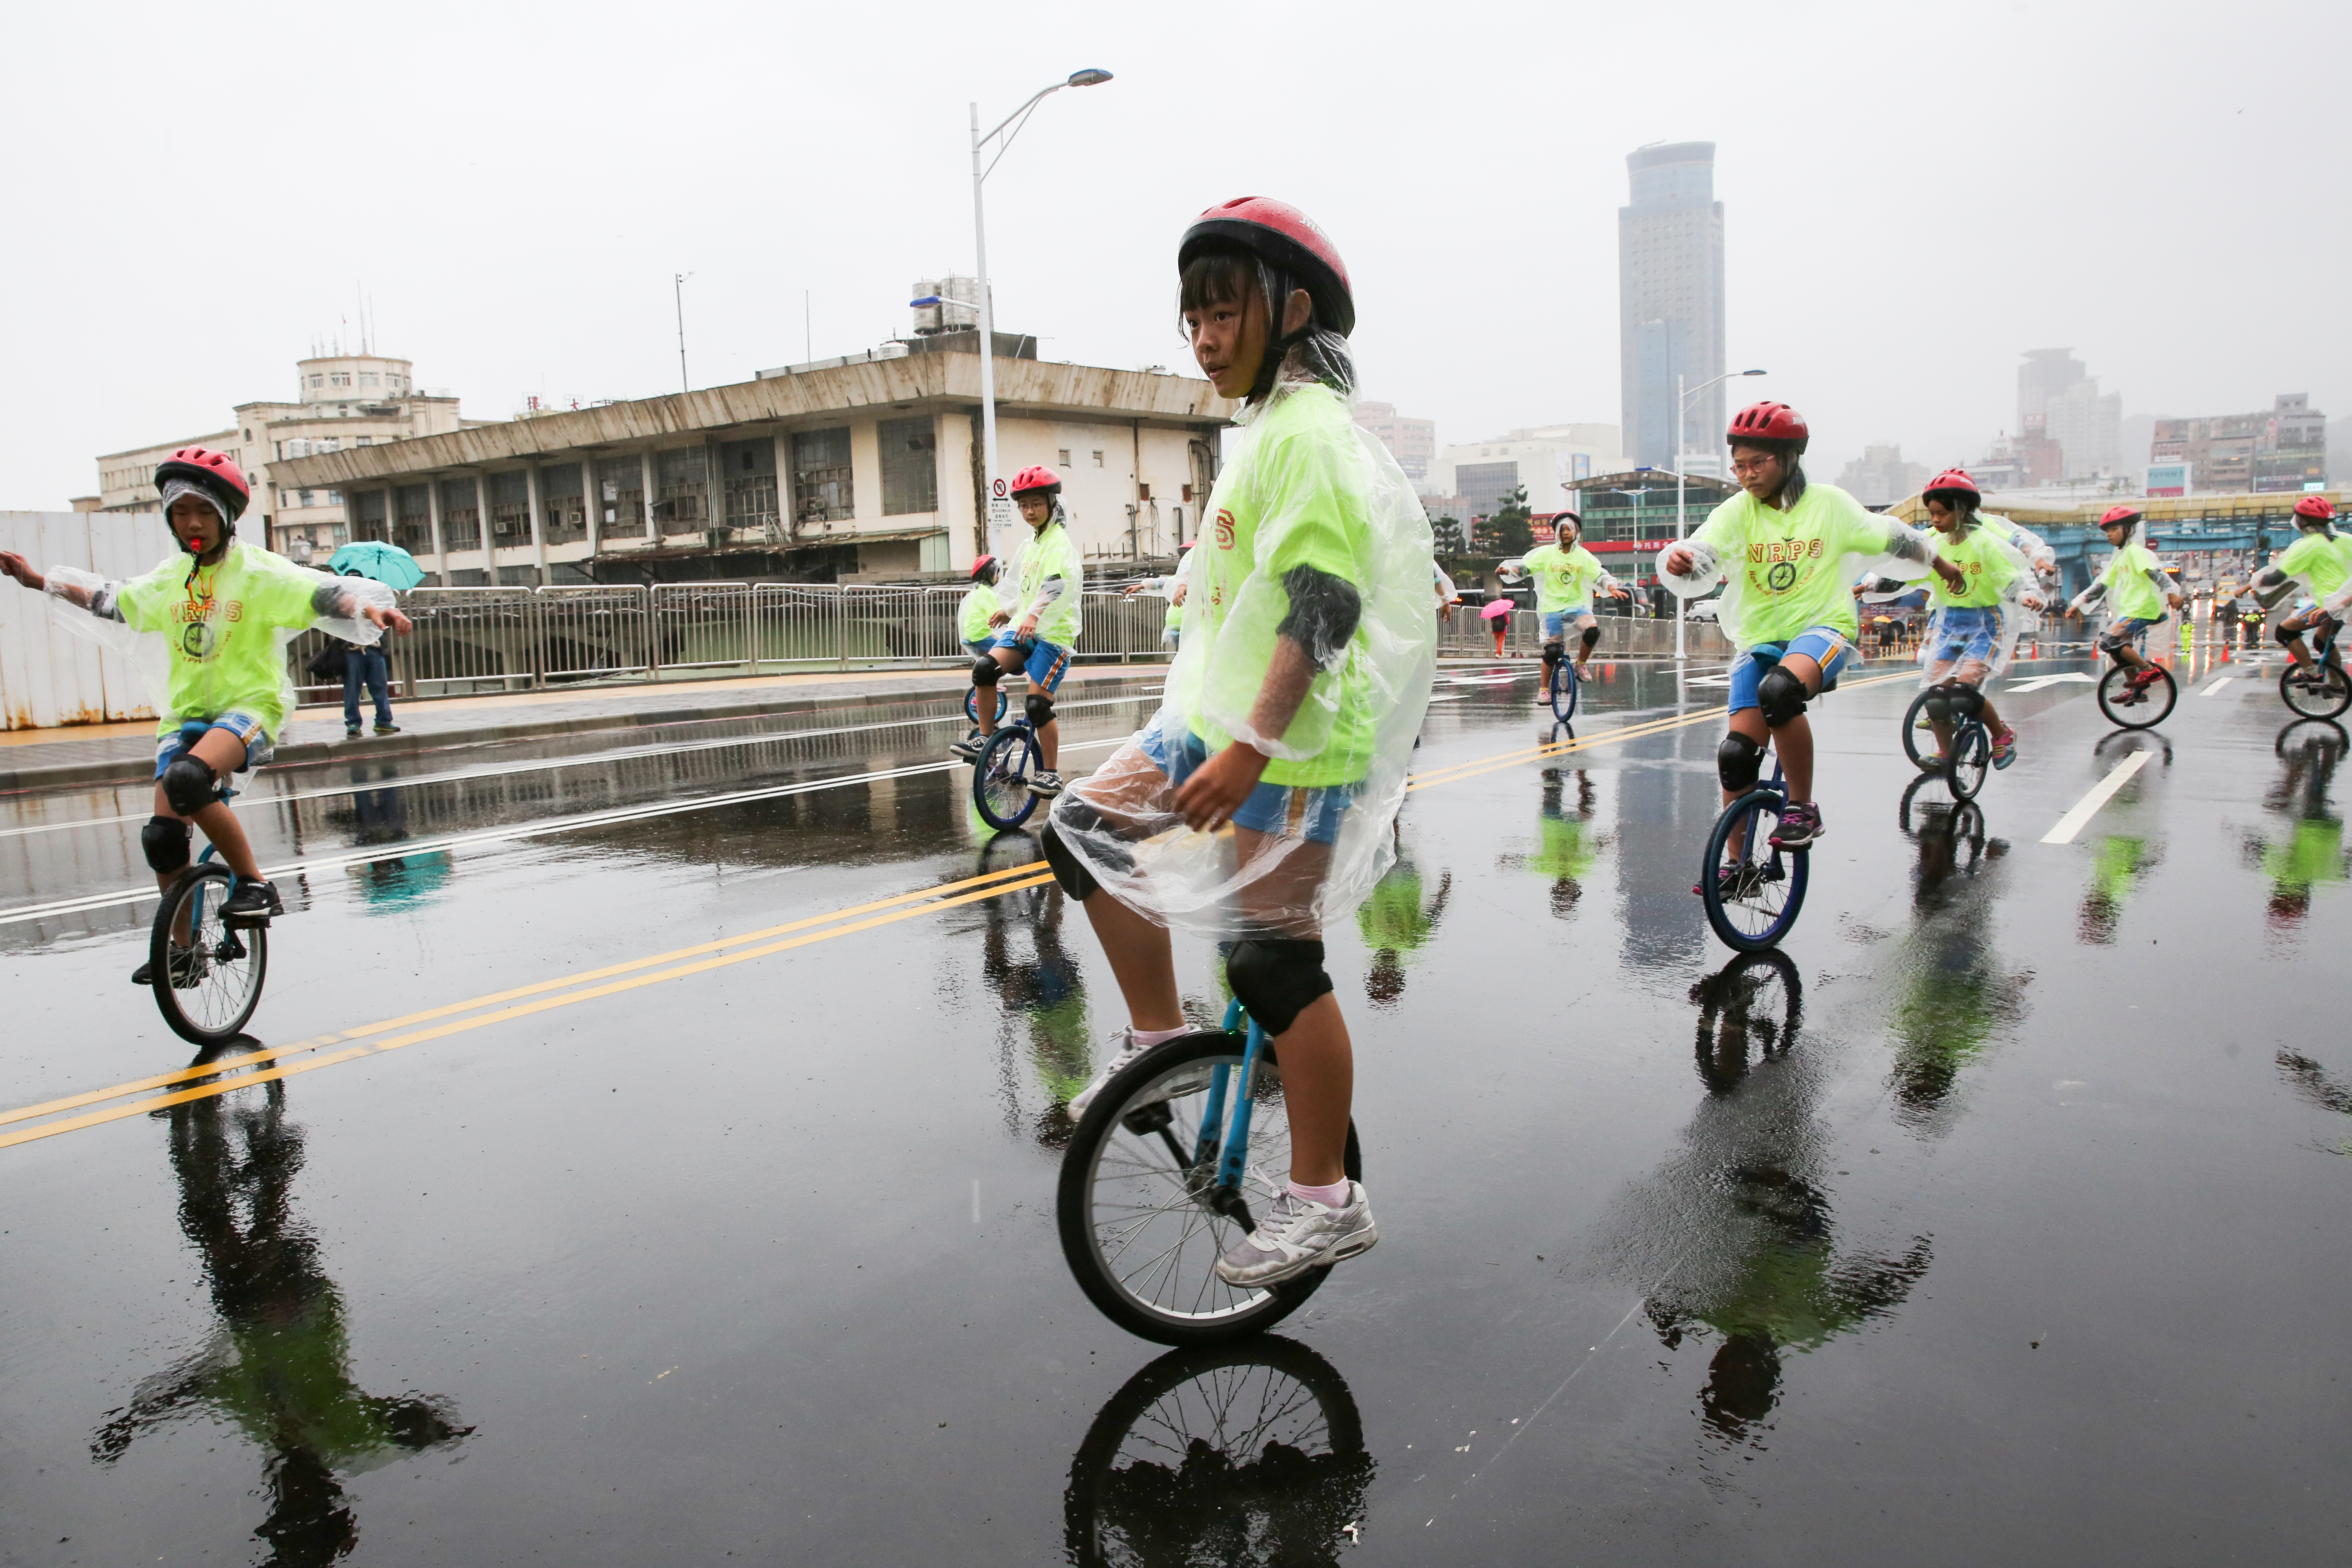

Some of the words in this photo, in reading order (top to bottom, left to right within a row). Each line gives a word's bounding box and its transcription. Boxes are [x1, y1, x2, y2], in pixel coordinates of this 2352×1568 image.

[1644, 541, 1675, 549] 托斯卡
[1748, 539, 1824, 563] NRPS
[1959, 562, 1982, 575] PS
